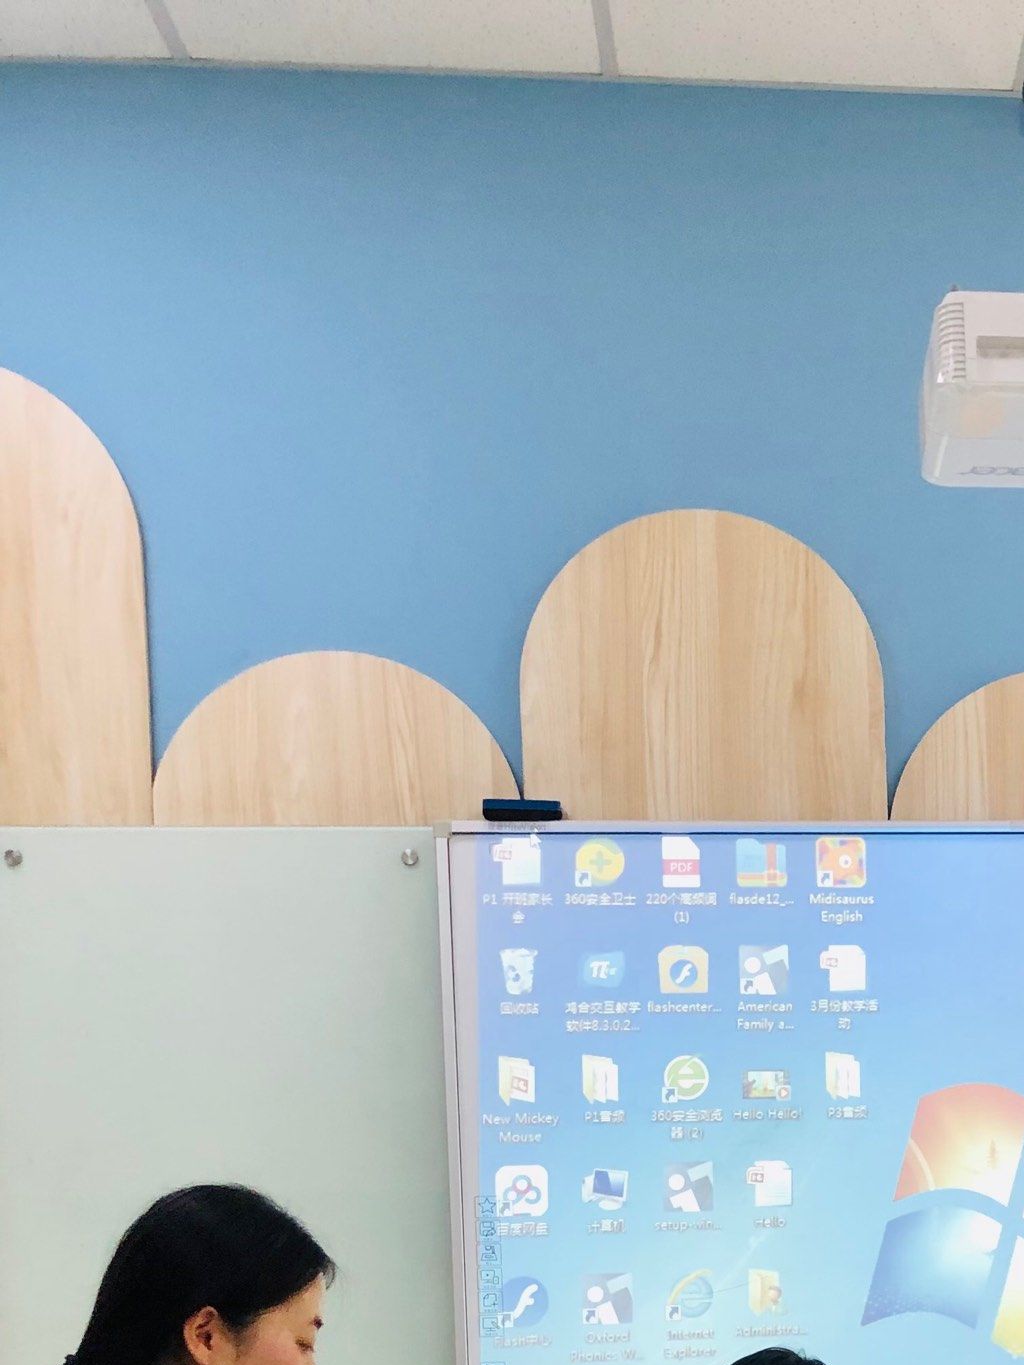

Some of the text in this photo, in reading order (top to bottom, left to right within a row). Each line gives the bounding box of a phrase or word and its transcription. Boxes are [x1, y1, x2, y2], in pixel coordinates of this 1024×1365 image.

[670, 862, 693, 873] PDF
[482, 894, 498, 906] P1
[565, 892, 637, 906] 360安全卫士
[809, 893, 875, 905] Midisaurus
[673, 911, 690, 924] (1)
[821, 911, 863, 925] English
[737, 1001, 793, 1012] American
[737, 1018, 774, 1032] Family
[482, 1112, 559, 1126] New Mickey
[733, 1109, 763, 1121] Hello
[499, 1131, 542, 1143] Mouse
[754, 1216, 786, 1229] Hello
